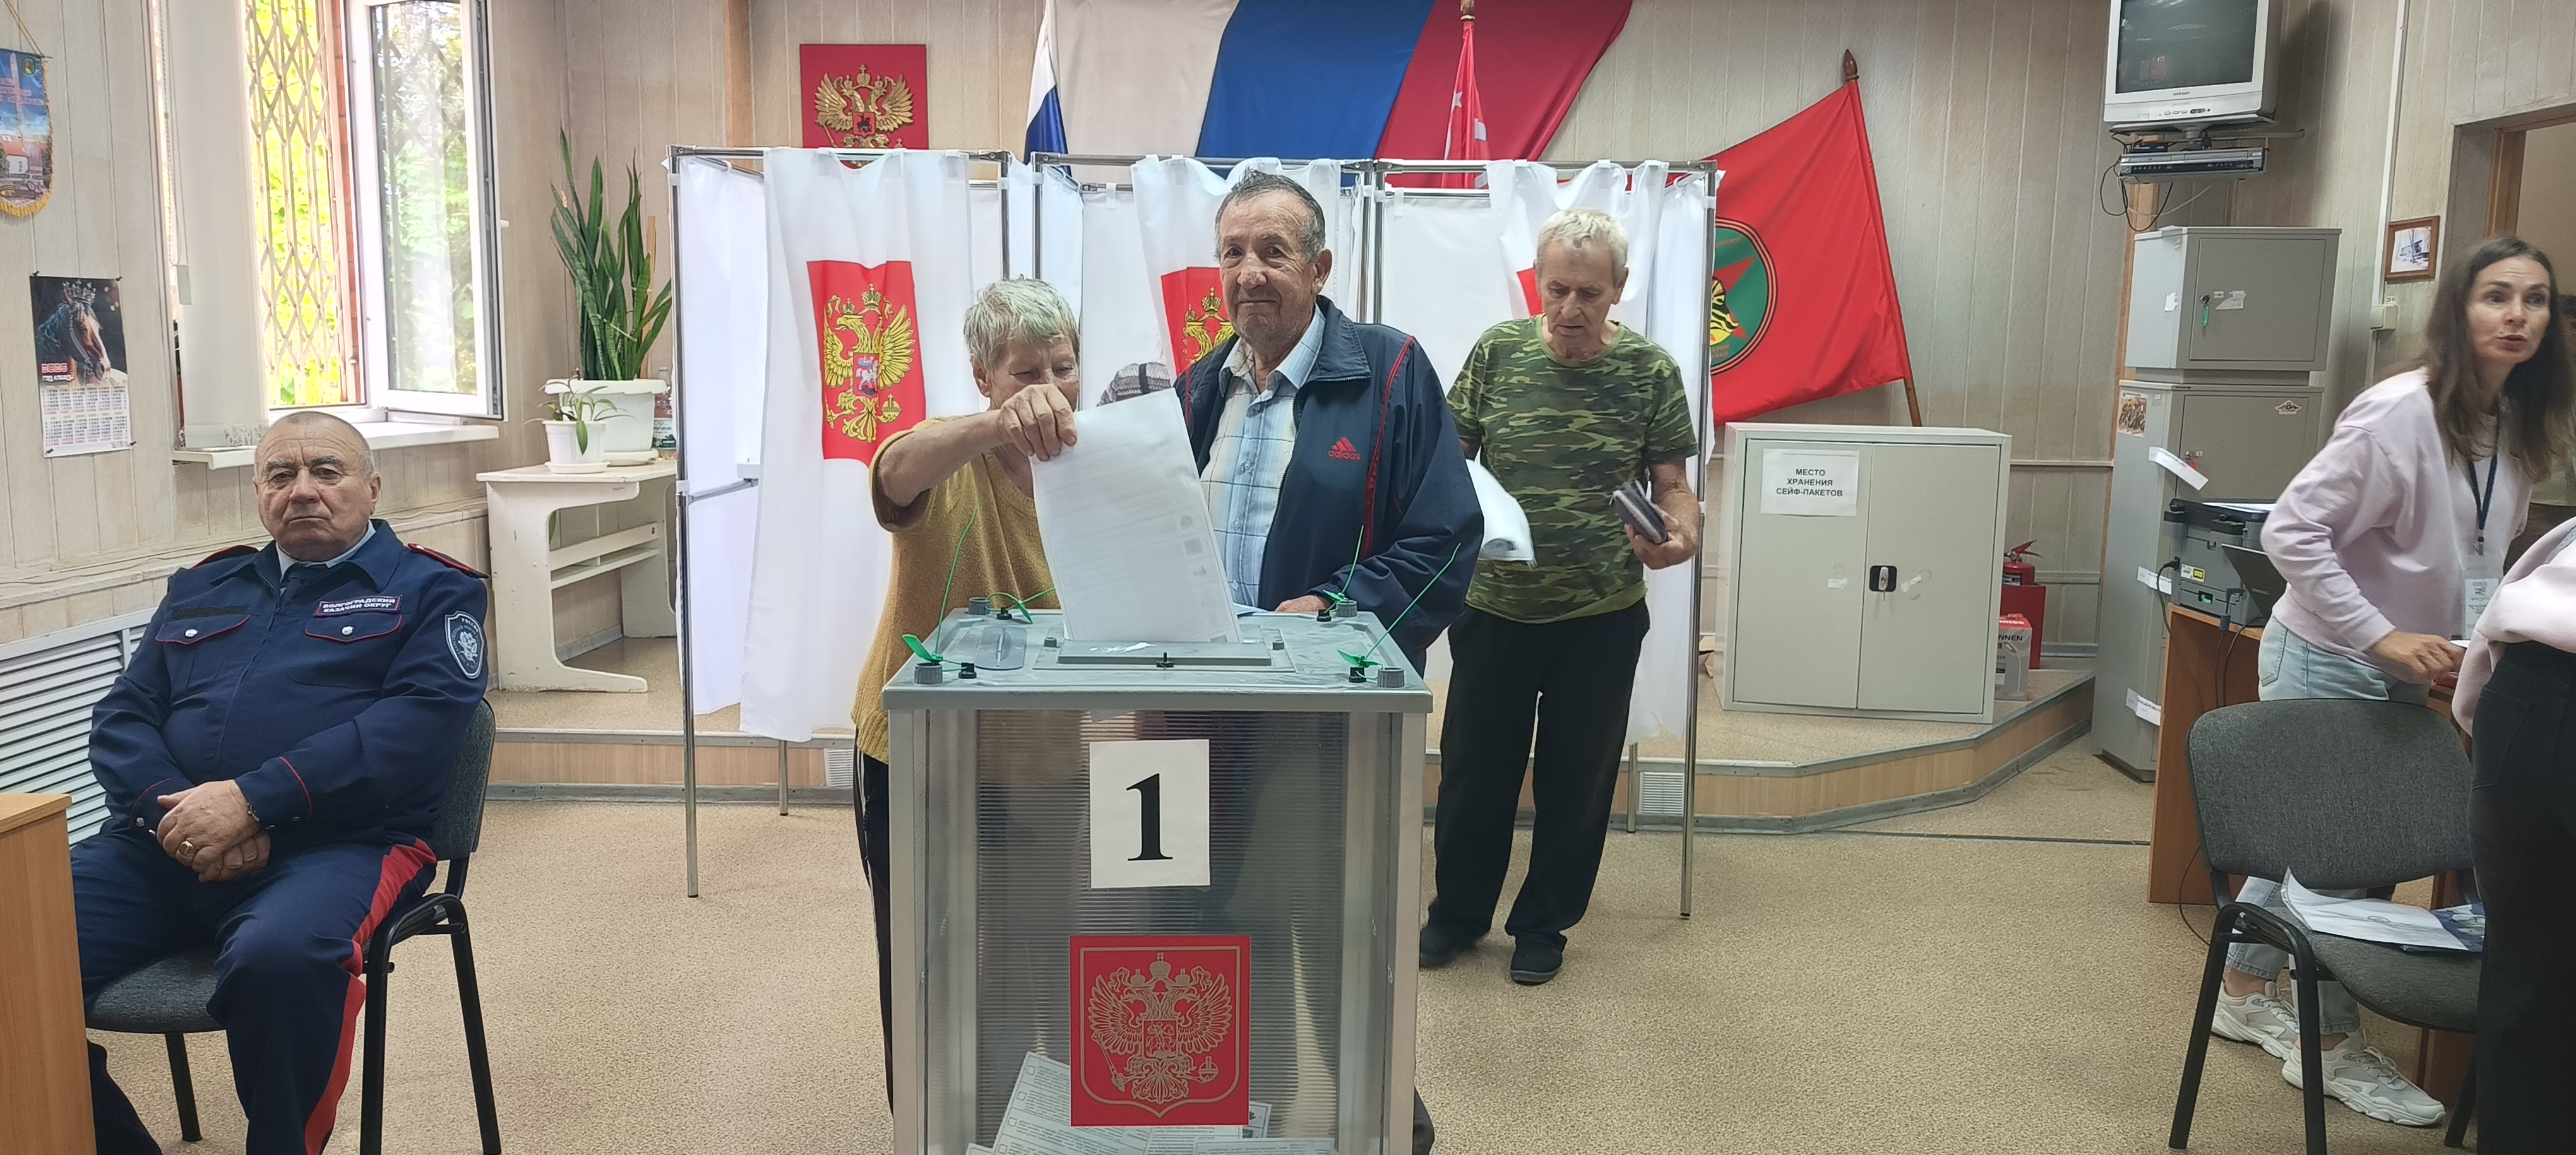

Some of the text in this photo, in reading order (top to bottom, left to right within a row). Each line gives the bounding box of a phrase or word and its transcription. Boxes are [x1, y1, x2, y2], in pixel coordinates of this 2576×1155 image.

[1328, 450, 1361, 461] adidas
[1787, 478, 1833, 486] ХРАНЕНИЯ
[1776, 487, 1843, 497] СЕЙФ-ПАКЕТОВ
[1125, 772, 1174, 862] 1
